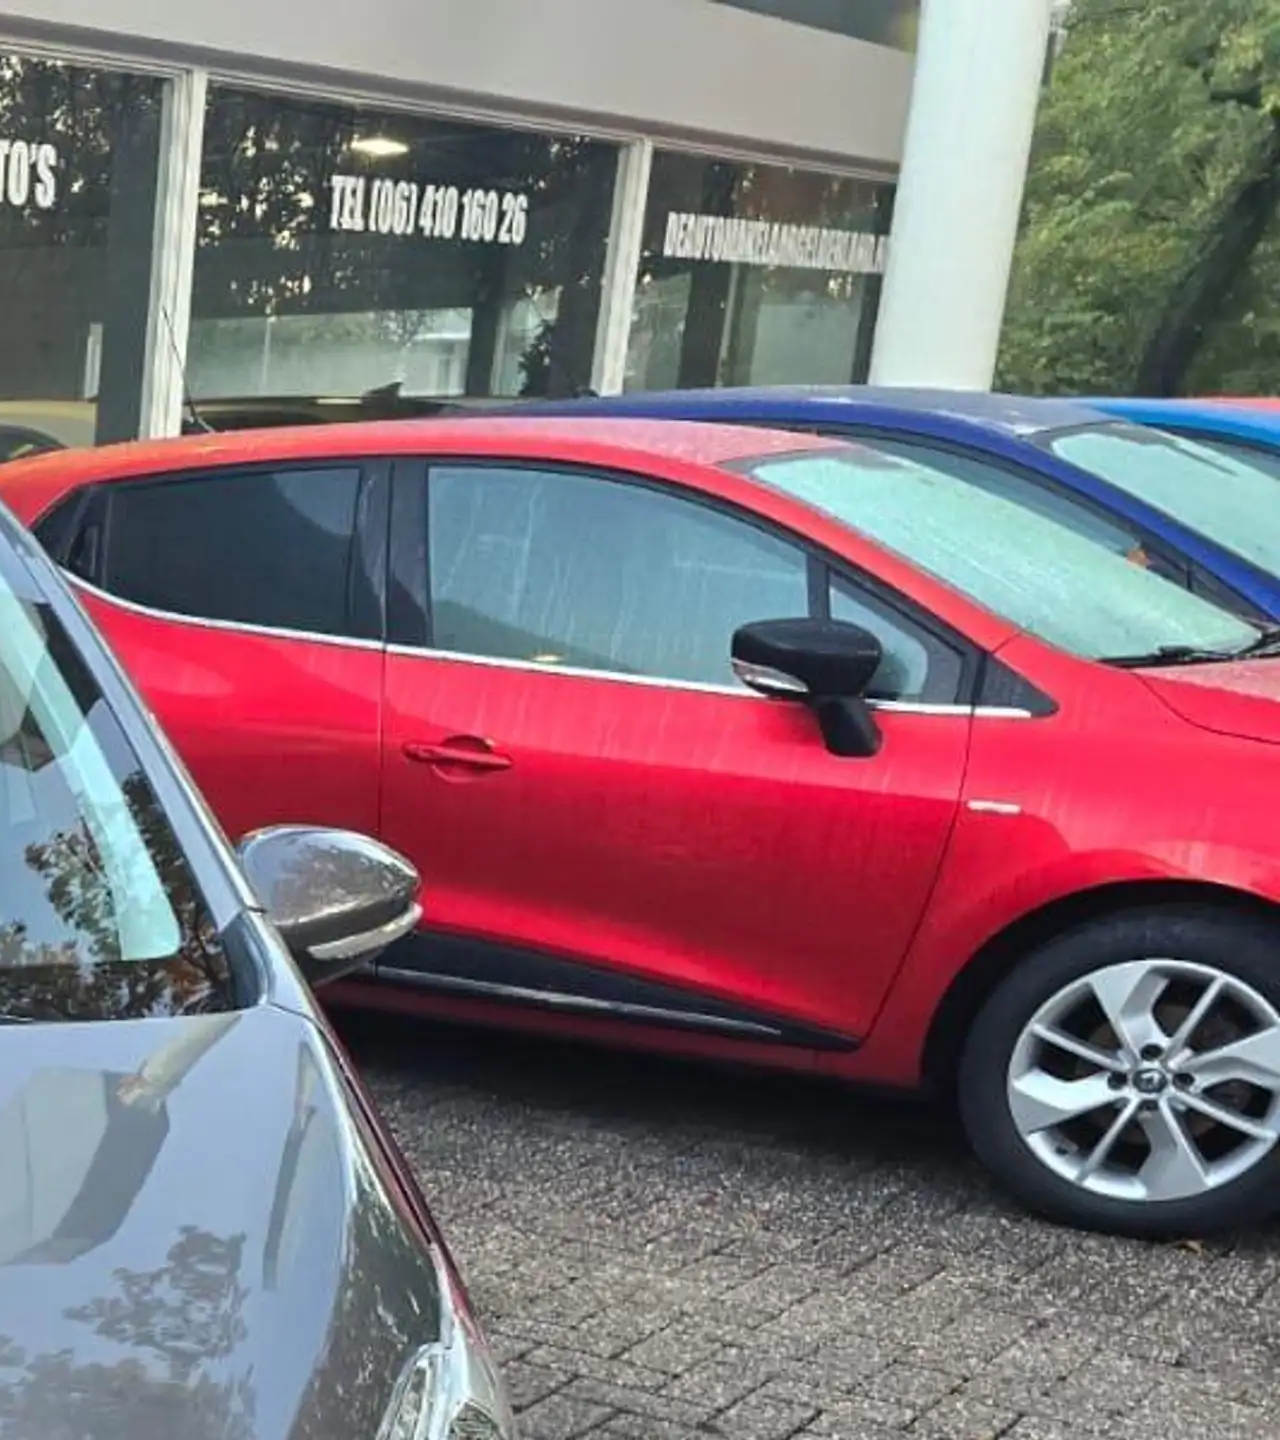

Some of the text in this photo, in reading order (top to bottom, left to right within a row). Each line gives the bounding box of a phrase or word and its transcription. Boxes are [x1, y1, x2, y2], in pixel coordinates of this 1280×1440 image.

[330, 174, 529, 245] TEL (06) 410 160 26
